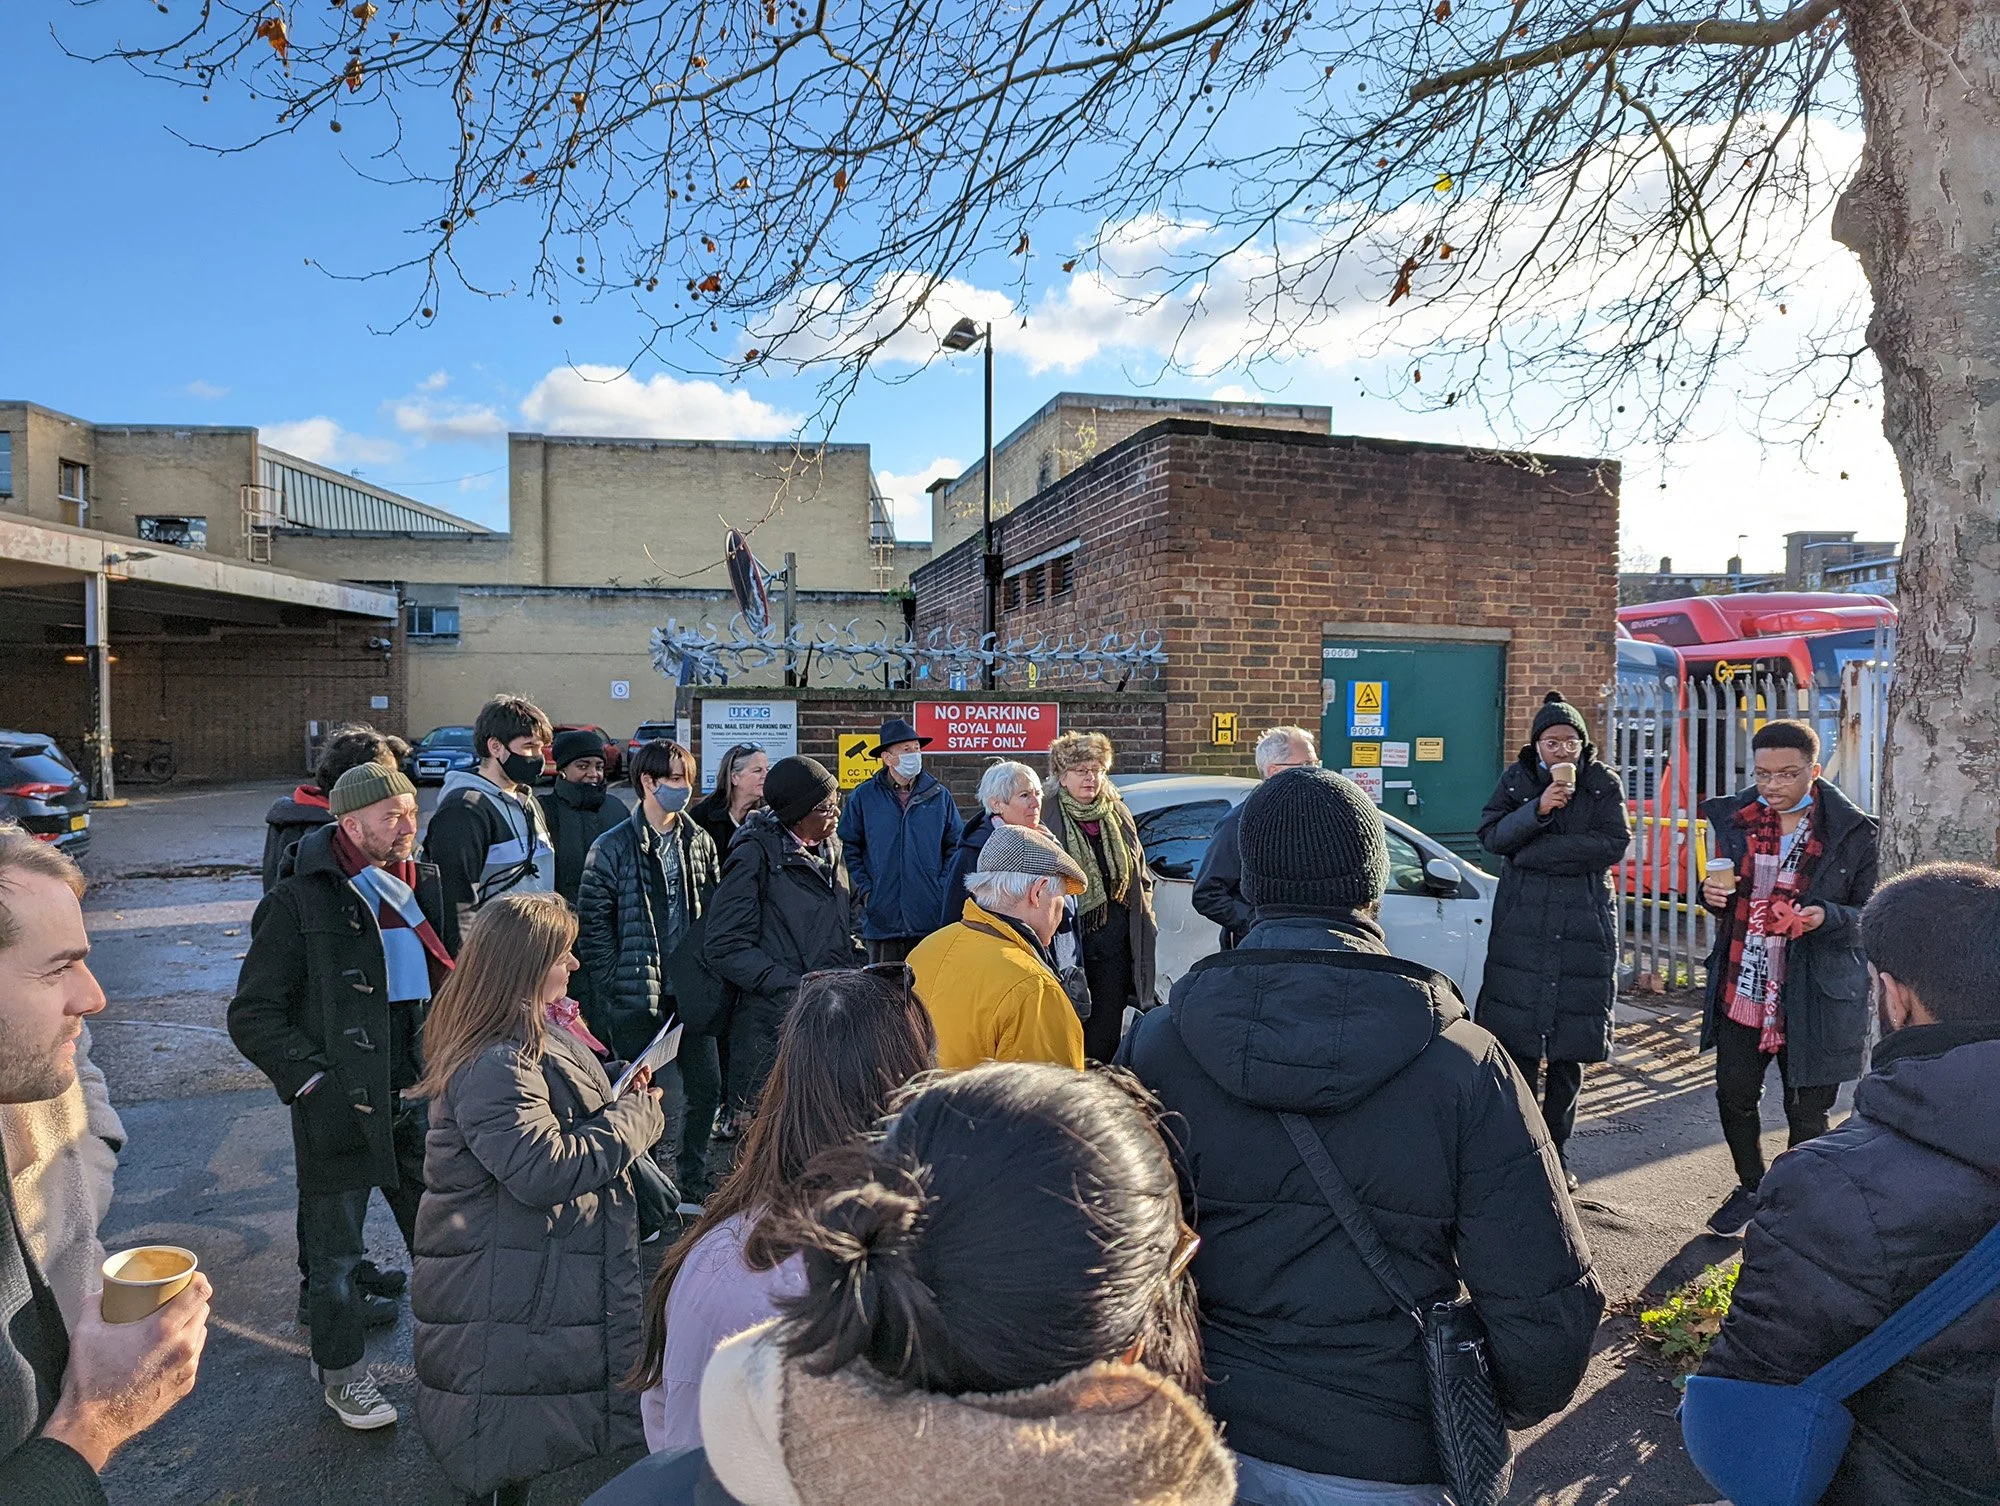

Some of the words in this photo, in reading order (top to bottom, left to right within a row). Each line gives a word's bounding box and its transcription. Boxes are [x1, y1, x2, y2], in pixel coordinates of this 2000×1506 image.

[1324, 649, 1356, 657] 90067
[730, 708, 770, 717] UKPC
[935, 705, 960, 720] NO
[965, 705, 1040, 720] PARKING
[948, 722, 992, 734] ROYAL
[995, 722, 1027, 734] MAIL
[1351, 727, 1382, 735] 90067
[1220, 732, 1228, 740] 15
[948, 736, 989, 748] STAFF
[992, 736, 1027, 748] ONLY
[847, 768, 860, 777] CC
[863, 768, 875, 776] TV
